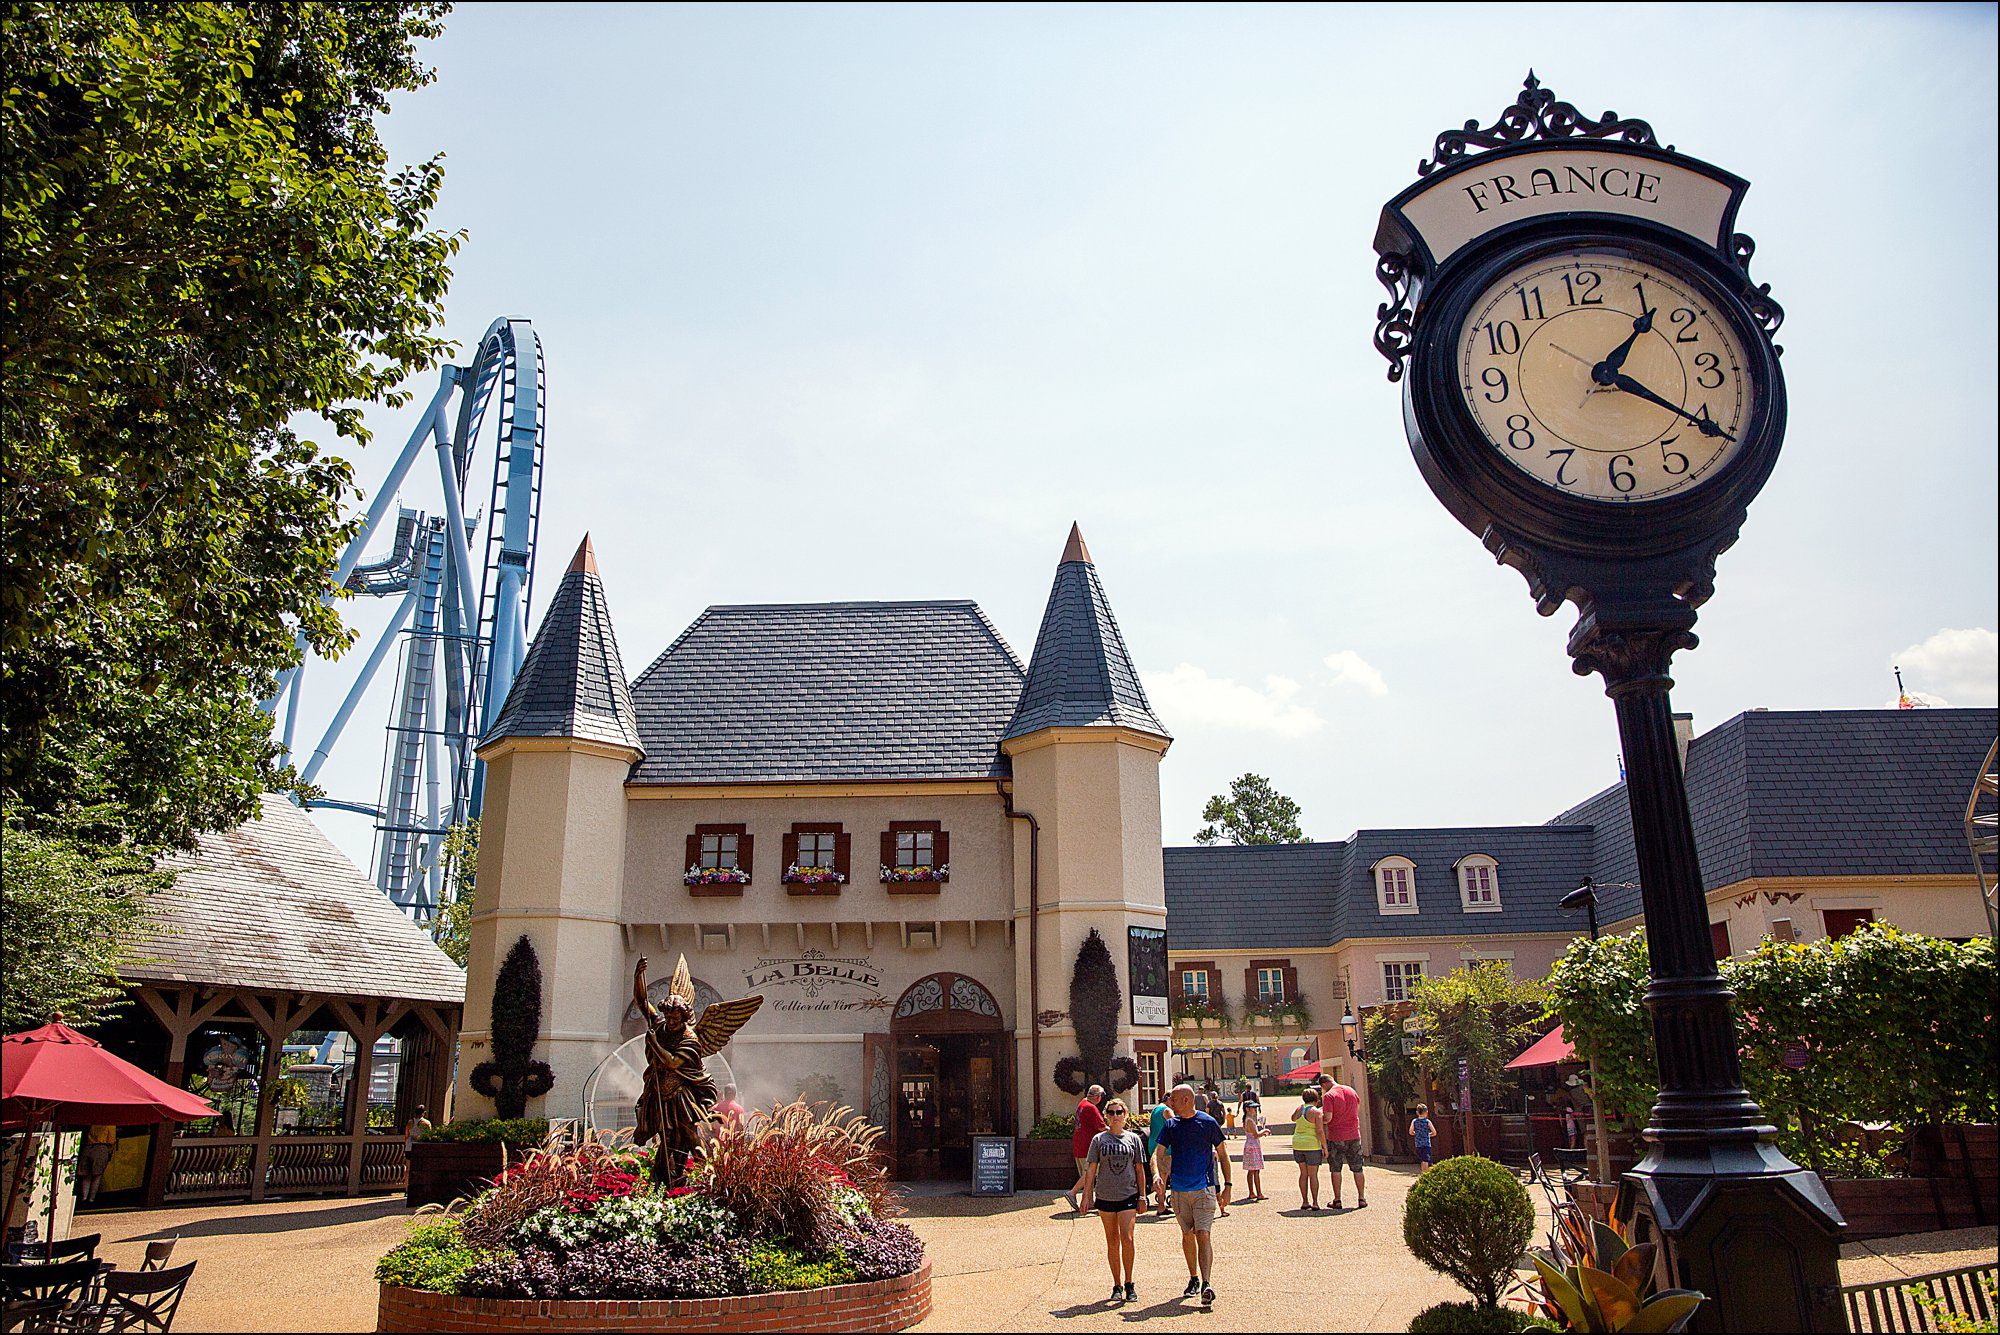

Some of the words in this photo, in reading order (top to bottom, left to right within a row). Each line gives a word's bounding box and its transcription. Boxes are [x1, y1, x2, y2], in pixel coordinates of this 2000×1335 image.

[1461, 165, 1663, 214] FRANCE
[1516, 286, 1549, 321] 11
[1560, 270, 1604, 307] 12
[1632, 282, 1650, 316] 1
[1483, 319, 1521, 356] 10
[1670, 307, 1700, 343] 2
[1481, 367, 1509, 403] 9
[1694, 352, 1725, 389] 3
[1506, 414, 1535, 450] 8
[1546, 448, 1578, 485] 7
[1659, 434, 1690, 475] 5
[1609, 454, 1636, 492] 6
[745, 969, 785, 989] LA
[792, 963, 880, 988] BELLE
[772, 1000, 813, 1012] Cellier
[814, 1000, 830, 1012] du
[832, 999, 853, 1011] Vin
[1135, 1005, 1167, 1016] AQUITAINE
